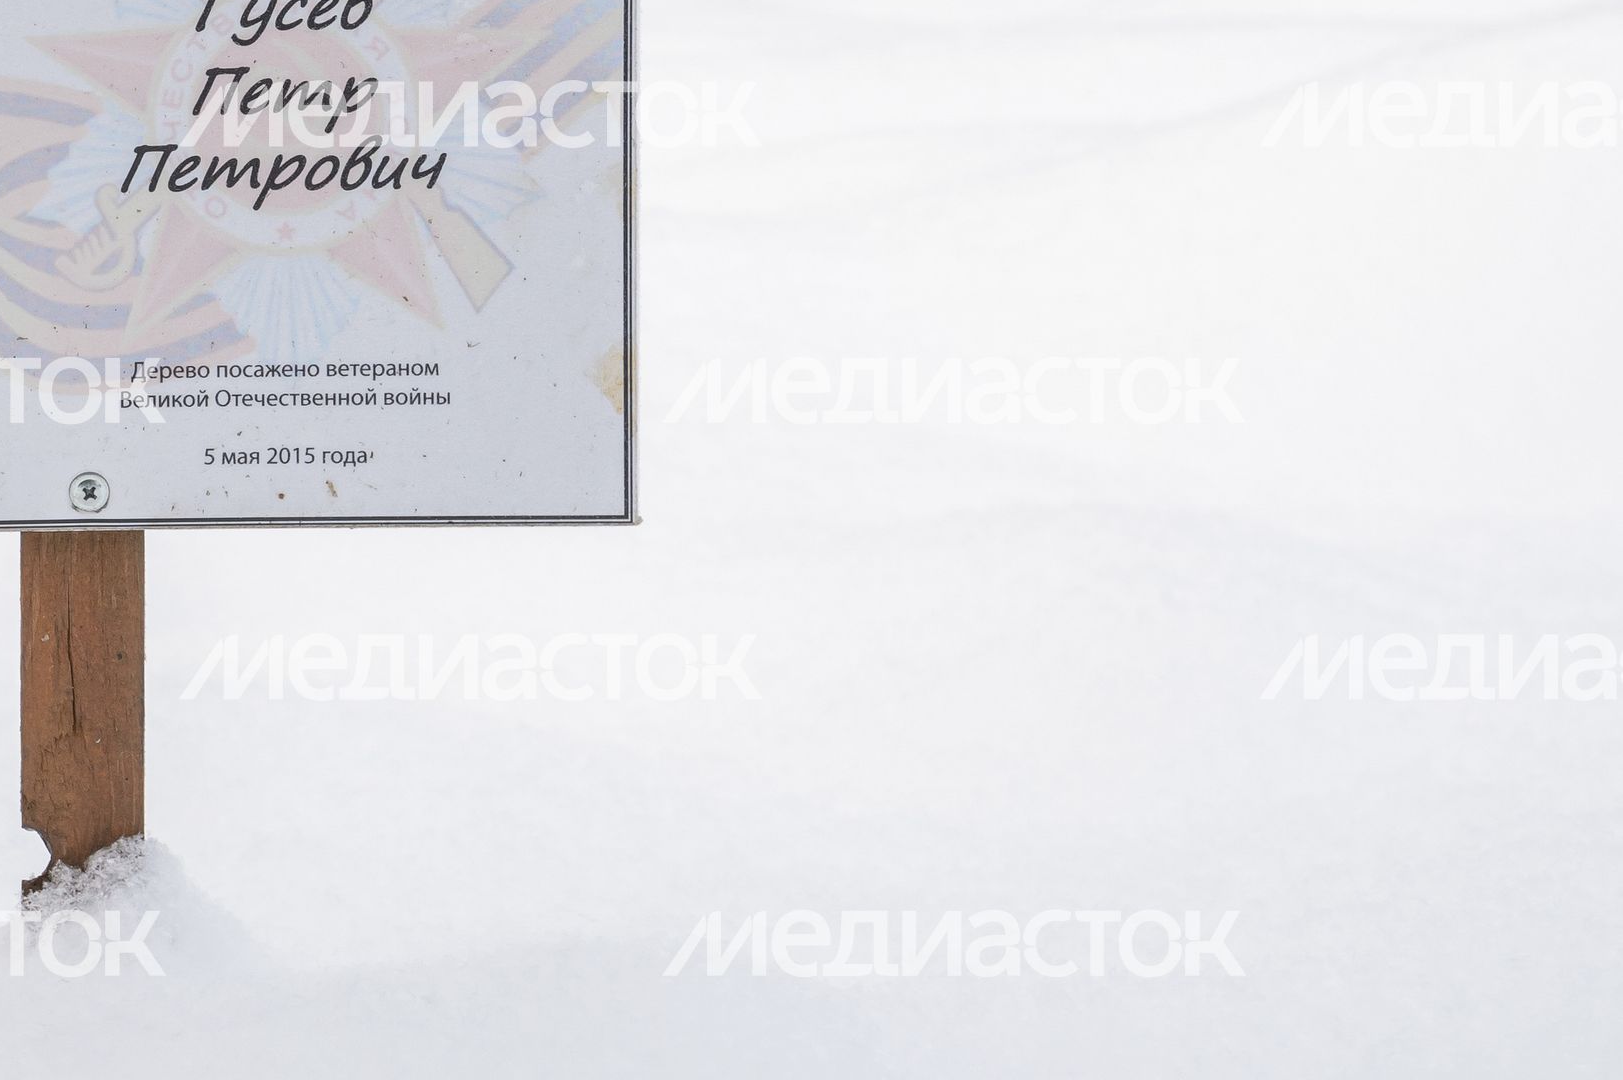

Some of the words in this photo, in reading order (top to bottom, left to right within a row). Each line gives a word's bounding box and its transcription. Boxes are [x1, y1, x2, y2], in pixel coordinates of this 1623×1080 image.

[191, 66, 379, 134] Петр
[120, 135, 448, 211] Петрович
[130, 361, 211, 384] Дерево
[216, 363, 320, 379] посажено
[326, 362, 440, 382] ветераном
[120, 389, 210, 409] Великой
[214, 387, 377, 408] Отечественной
[383, 387, 451, 406] войны
[203, 447, 216, 466] 5
[221, 451, 260, 465] мая
[266, 447, 316, 465] 2015
[322, 450, 368, 468] года
